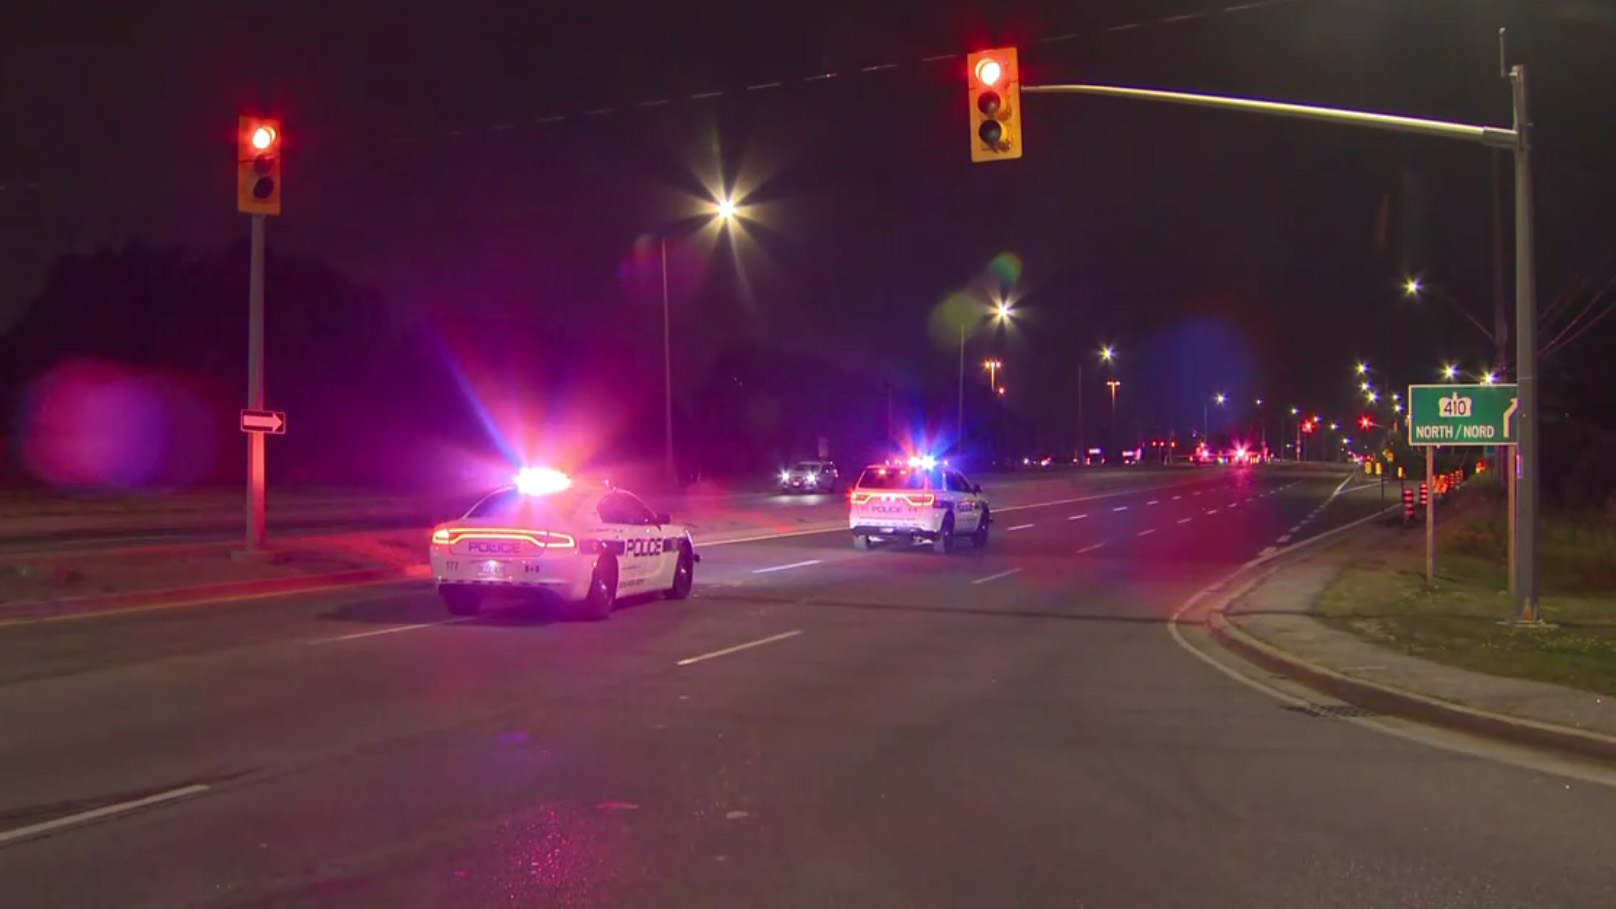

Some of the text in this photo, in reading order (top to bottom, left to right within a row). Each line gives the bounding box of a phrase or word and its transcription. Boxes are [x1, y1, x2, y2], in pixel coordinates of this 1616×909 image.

[1443, 400, 1467, 415] 410
[871, 505, 902, 513] POLICE
[468, 541, 521, 554] POLICE
[626, 538, 662, 557] POLICE
